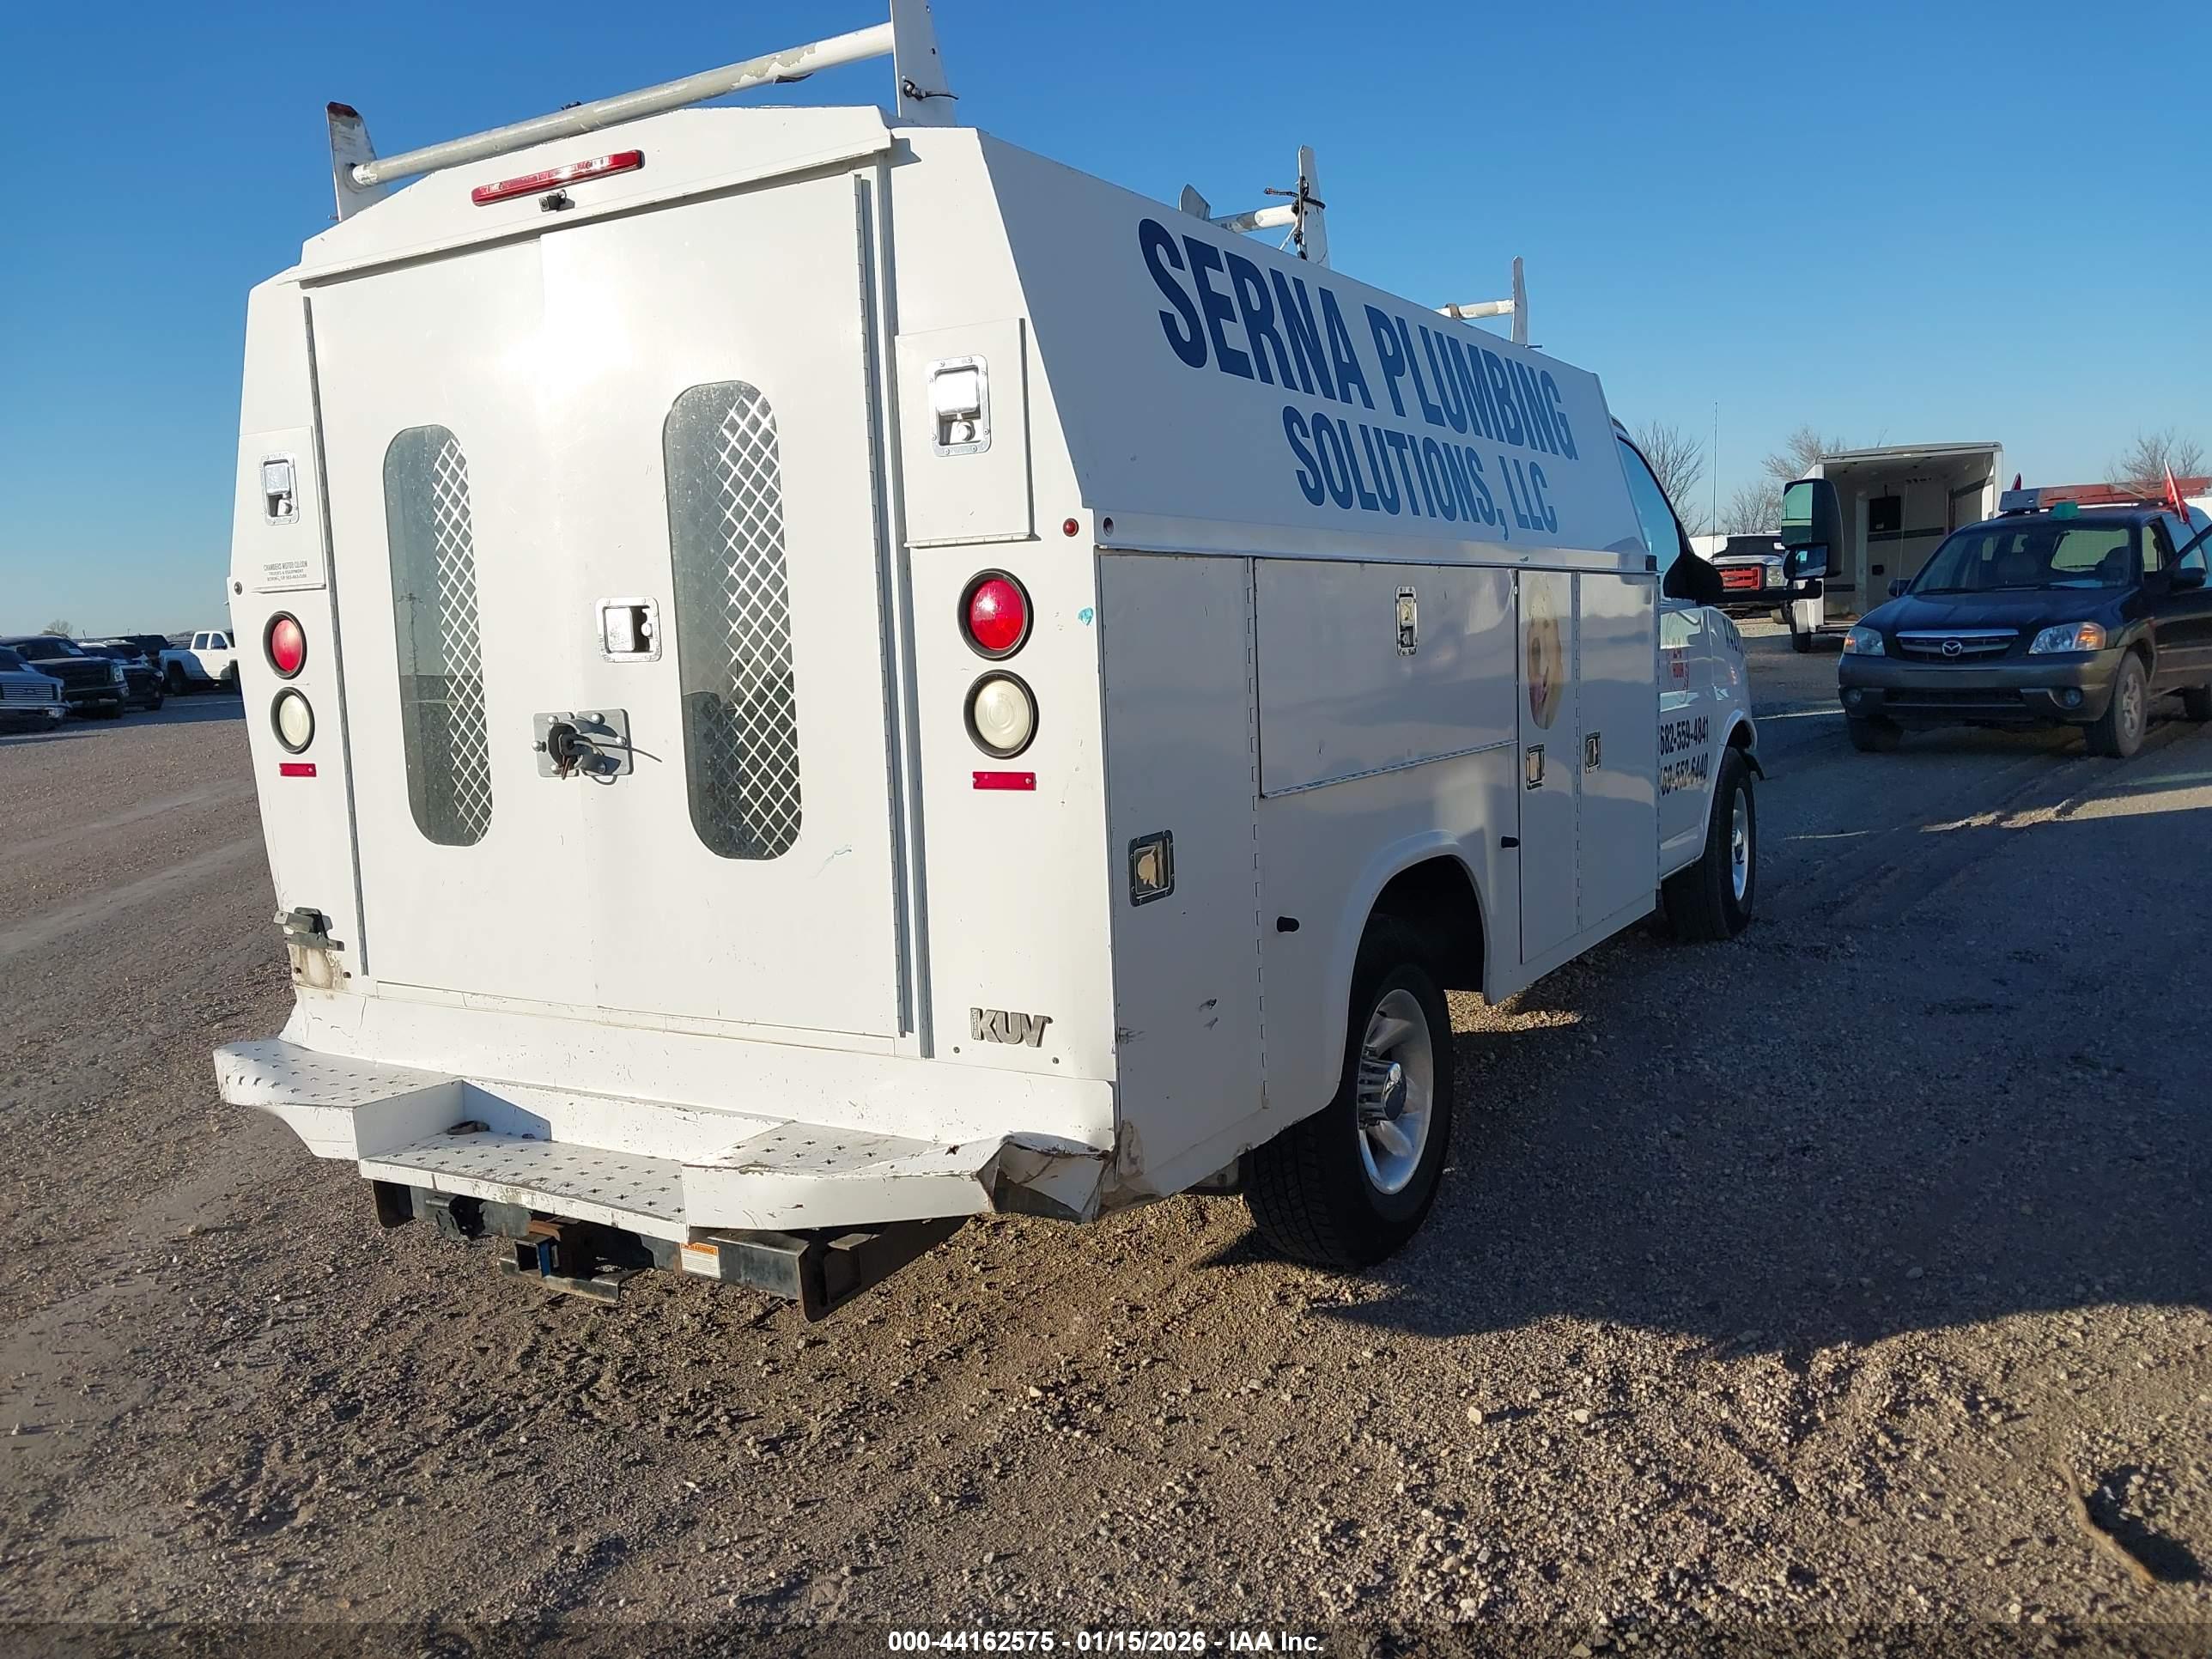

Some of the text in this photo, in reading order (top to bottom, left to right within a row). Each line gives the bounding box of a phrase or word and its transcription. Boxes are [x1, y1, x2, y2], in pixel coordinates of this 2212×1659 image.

[1138, 218, 1580, 461] SERNA PLUMBING
[1282, 405, 1559, 541] SOLUTIONS, LLC
[1660, 714, 1709, 757] 682-559-4841
[1660, 751, 1709, 797] 69-552-6440
[970, 1008, 1048, 1048] KUV
